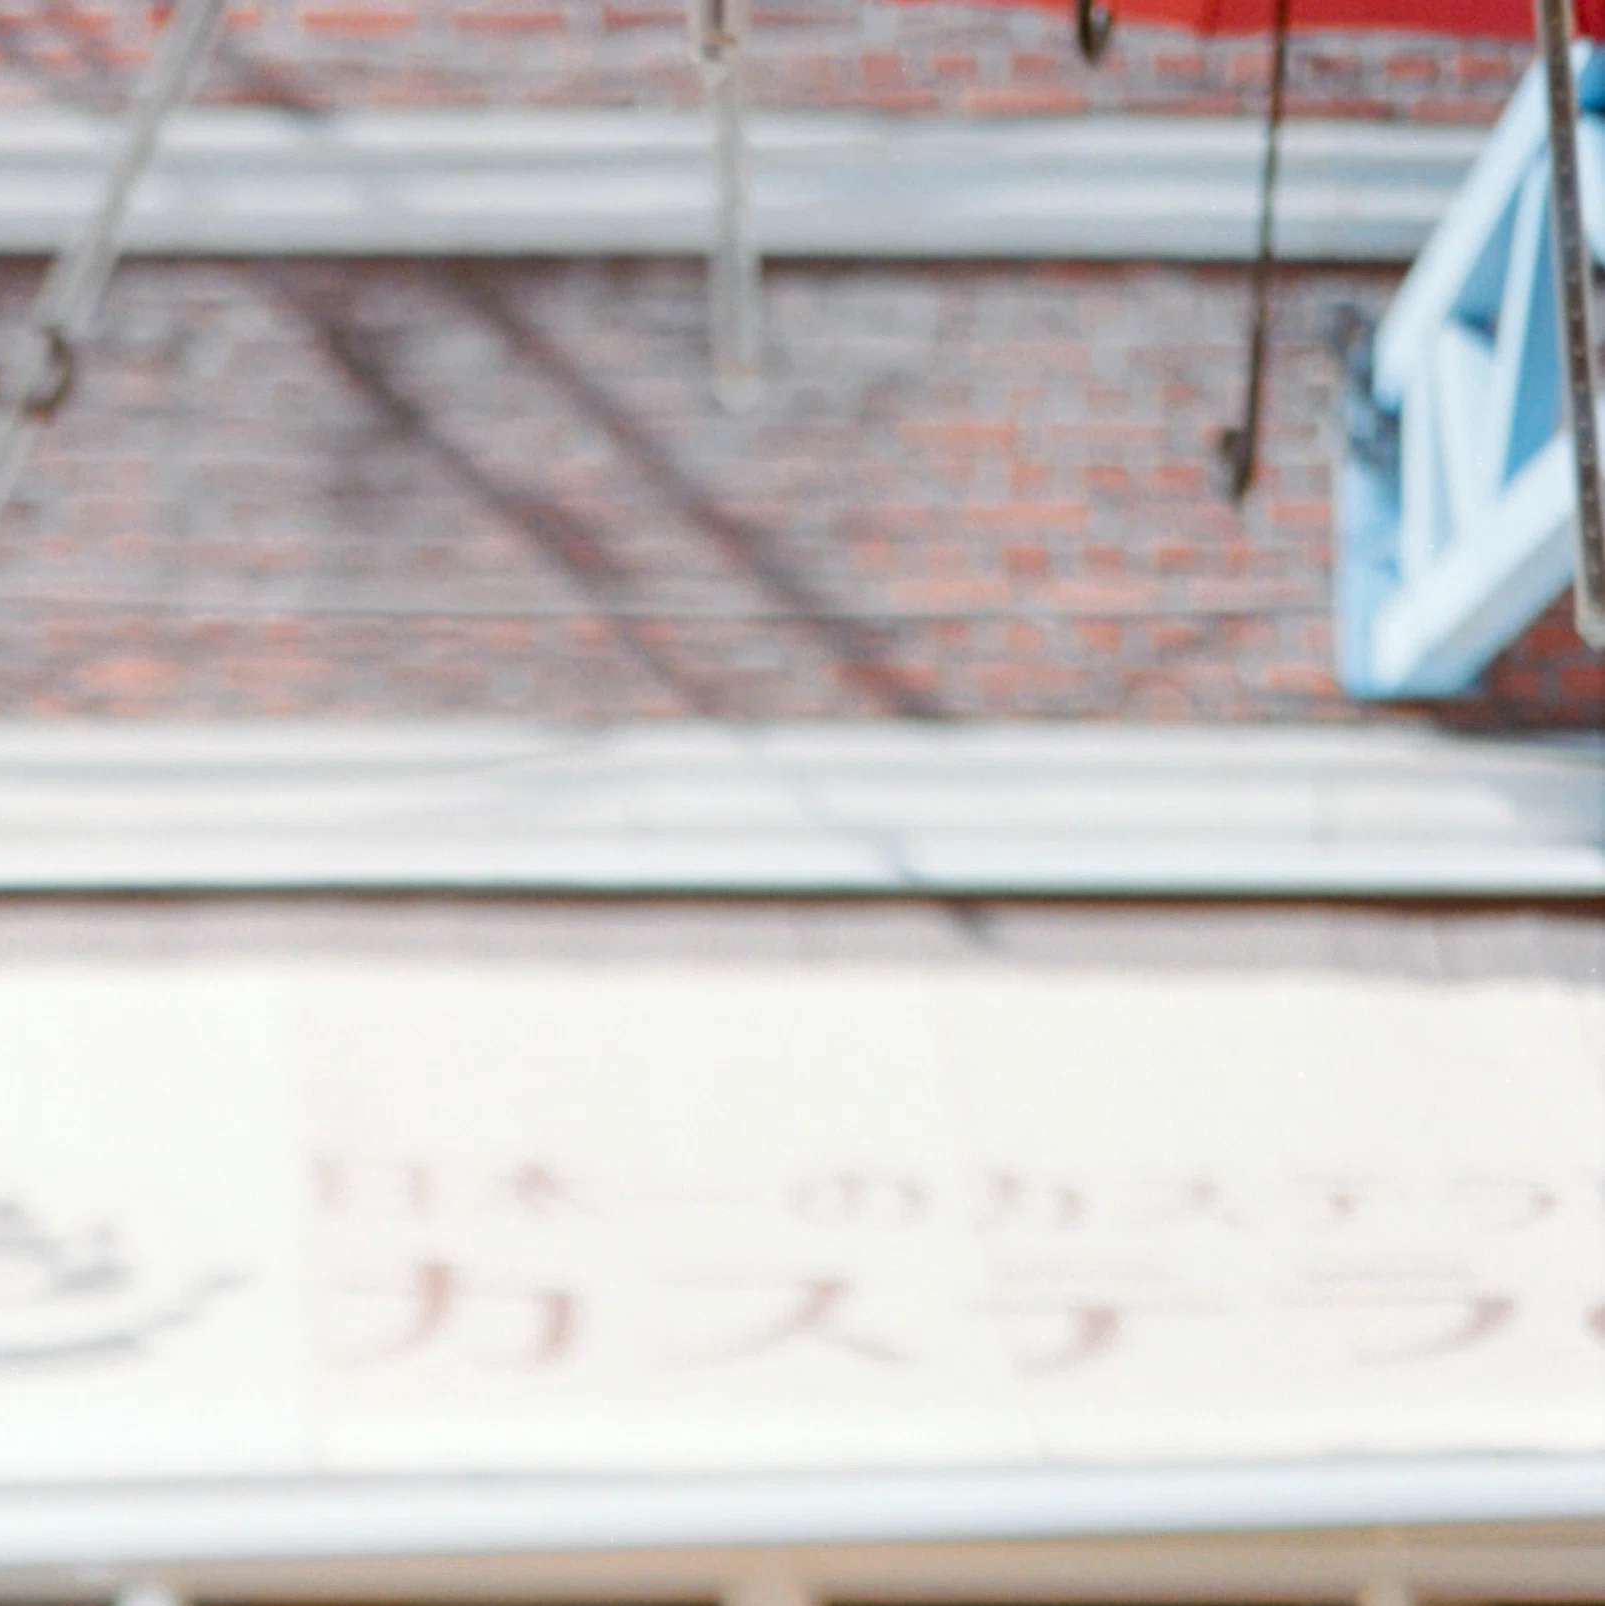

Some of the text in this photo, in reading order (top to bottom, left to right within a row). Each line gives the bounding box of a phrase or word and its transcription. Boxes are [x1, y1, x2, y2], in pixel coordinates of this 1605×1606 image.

[312, 1149, 1605, 1230] 日本一のカステラ
[316, 1254, 1605, 1376] カステラ
